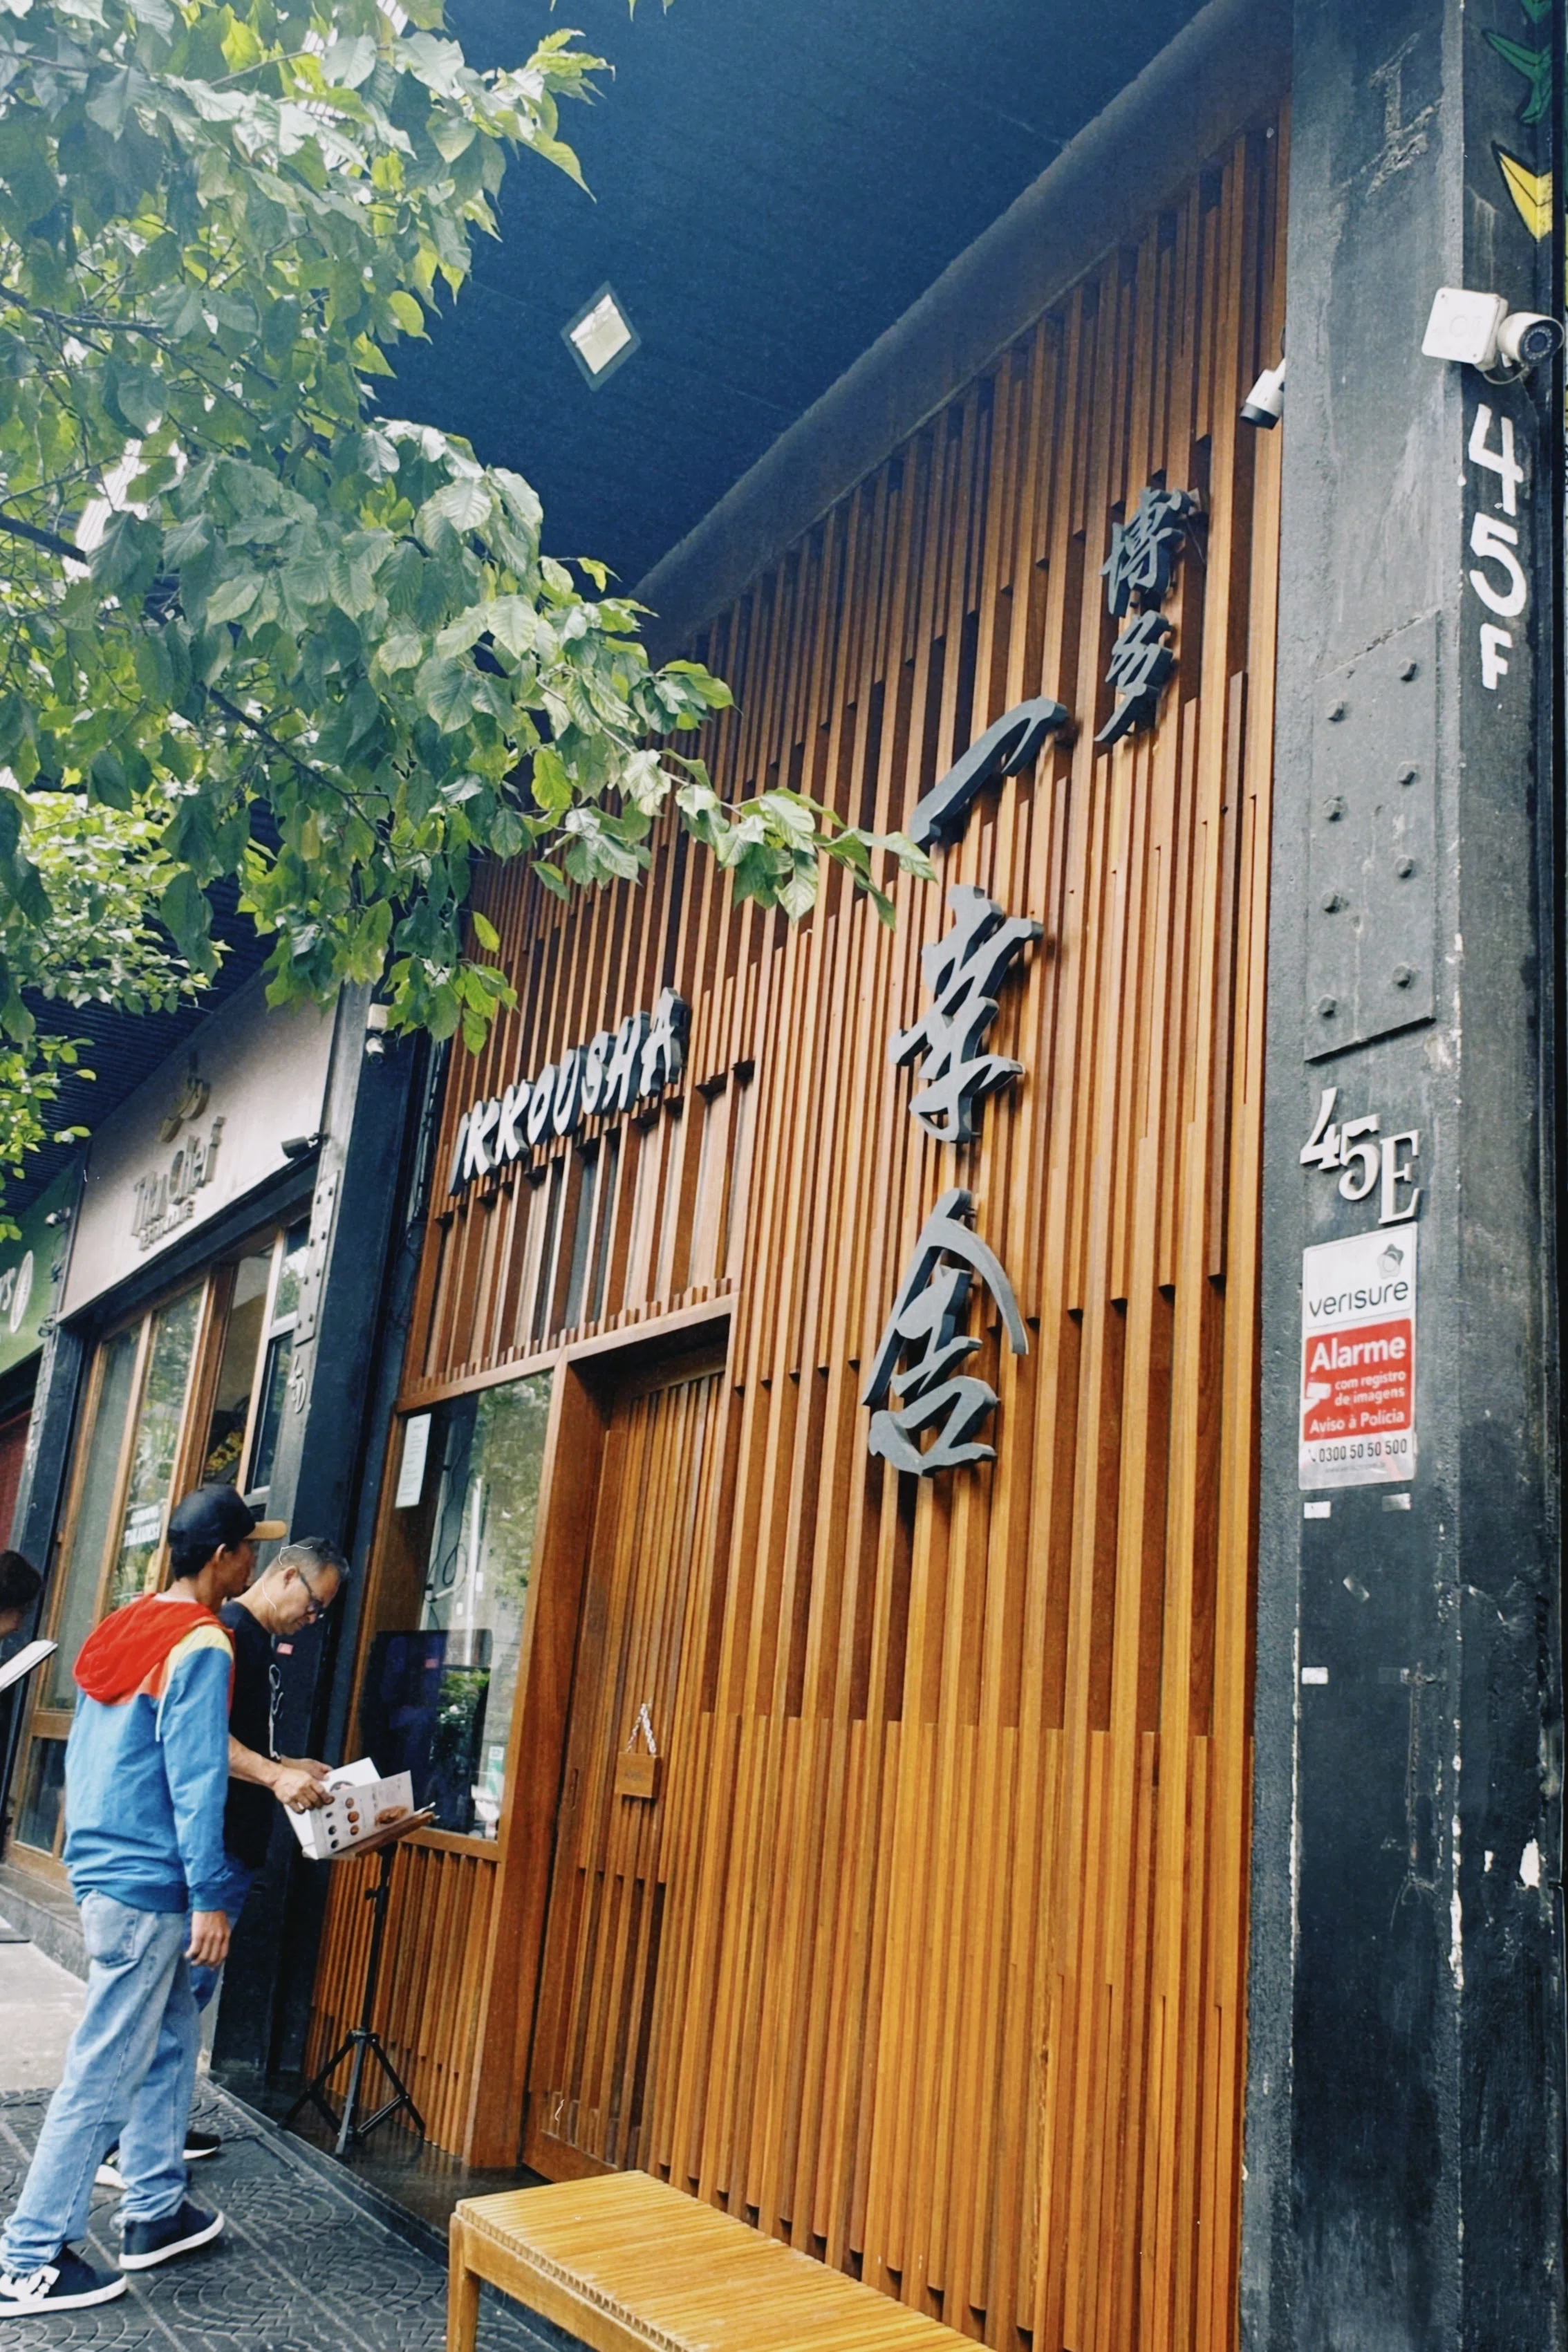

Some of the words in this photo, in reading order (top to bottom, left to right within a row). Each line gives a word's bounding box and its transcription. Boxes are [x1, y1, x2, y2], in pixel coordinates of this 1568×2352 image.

[1468, 403, 1527, 690] 45F
[1094, 486, 1200, 743] 博多
[448, 987, 689, 1197] IKKOUSHA
[1300, 1086, 1423, 1224] 45E
[1309, 1281, 1408, 1318] verisure
[1309, 1336, 1406, 1373] Alarme
[1334, 1392, 1351, 1406] de
[1353, 1387, 1406, 1405] imagens
[1335, 1378, 1359, 1391] com
[1361, 1370, 1406, 1389] registro
[1309, 1417, 1345, 1434] Aviso
[1348, 1414, 1357, 1429] à
[1360, 1408, 1406, 1428] Polícia
[1318, 1446, 1346, 1463] 0300
[1350, 1443, 1364, 1459] 50
[1367, 1441, 1381, 1457] 50
[1385, 1438, 1408, 1455] 500
